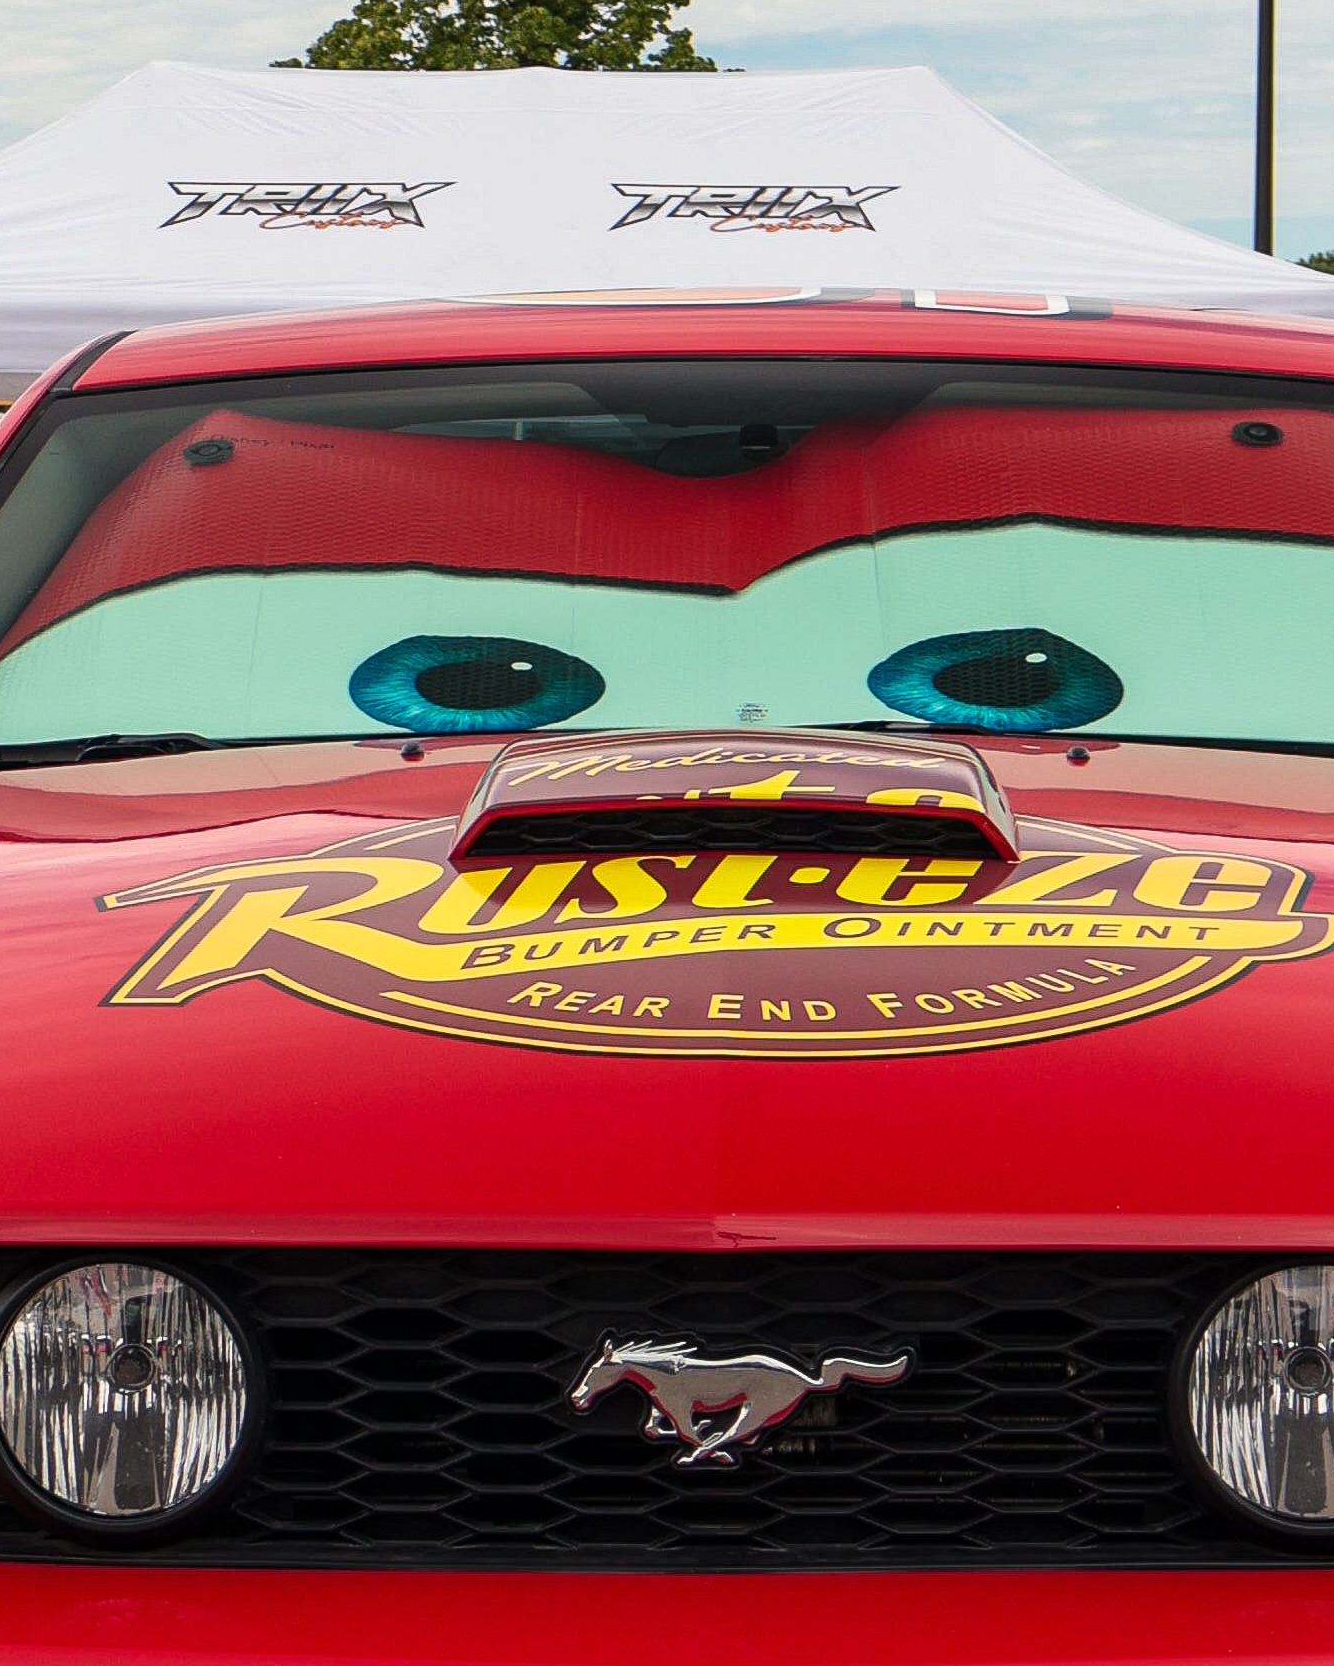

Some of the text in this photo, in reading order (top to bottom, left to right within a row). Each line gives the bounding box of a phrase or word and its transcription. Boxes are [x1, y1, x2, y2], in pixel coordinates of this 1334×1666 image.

[508, 746, 945, 785] Medicated
[459, 916, 1220, 970] BUMPER OINTMENT
[508, 957, 1136, 1021] REAR END FORMULA
